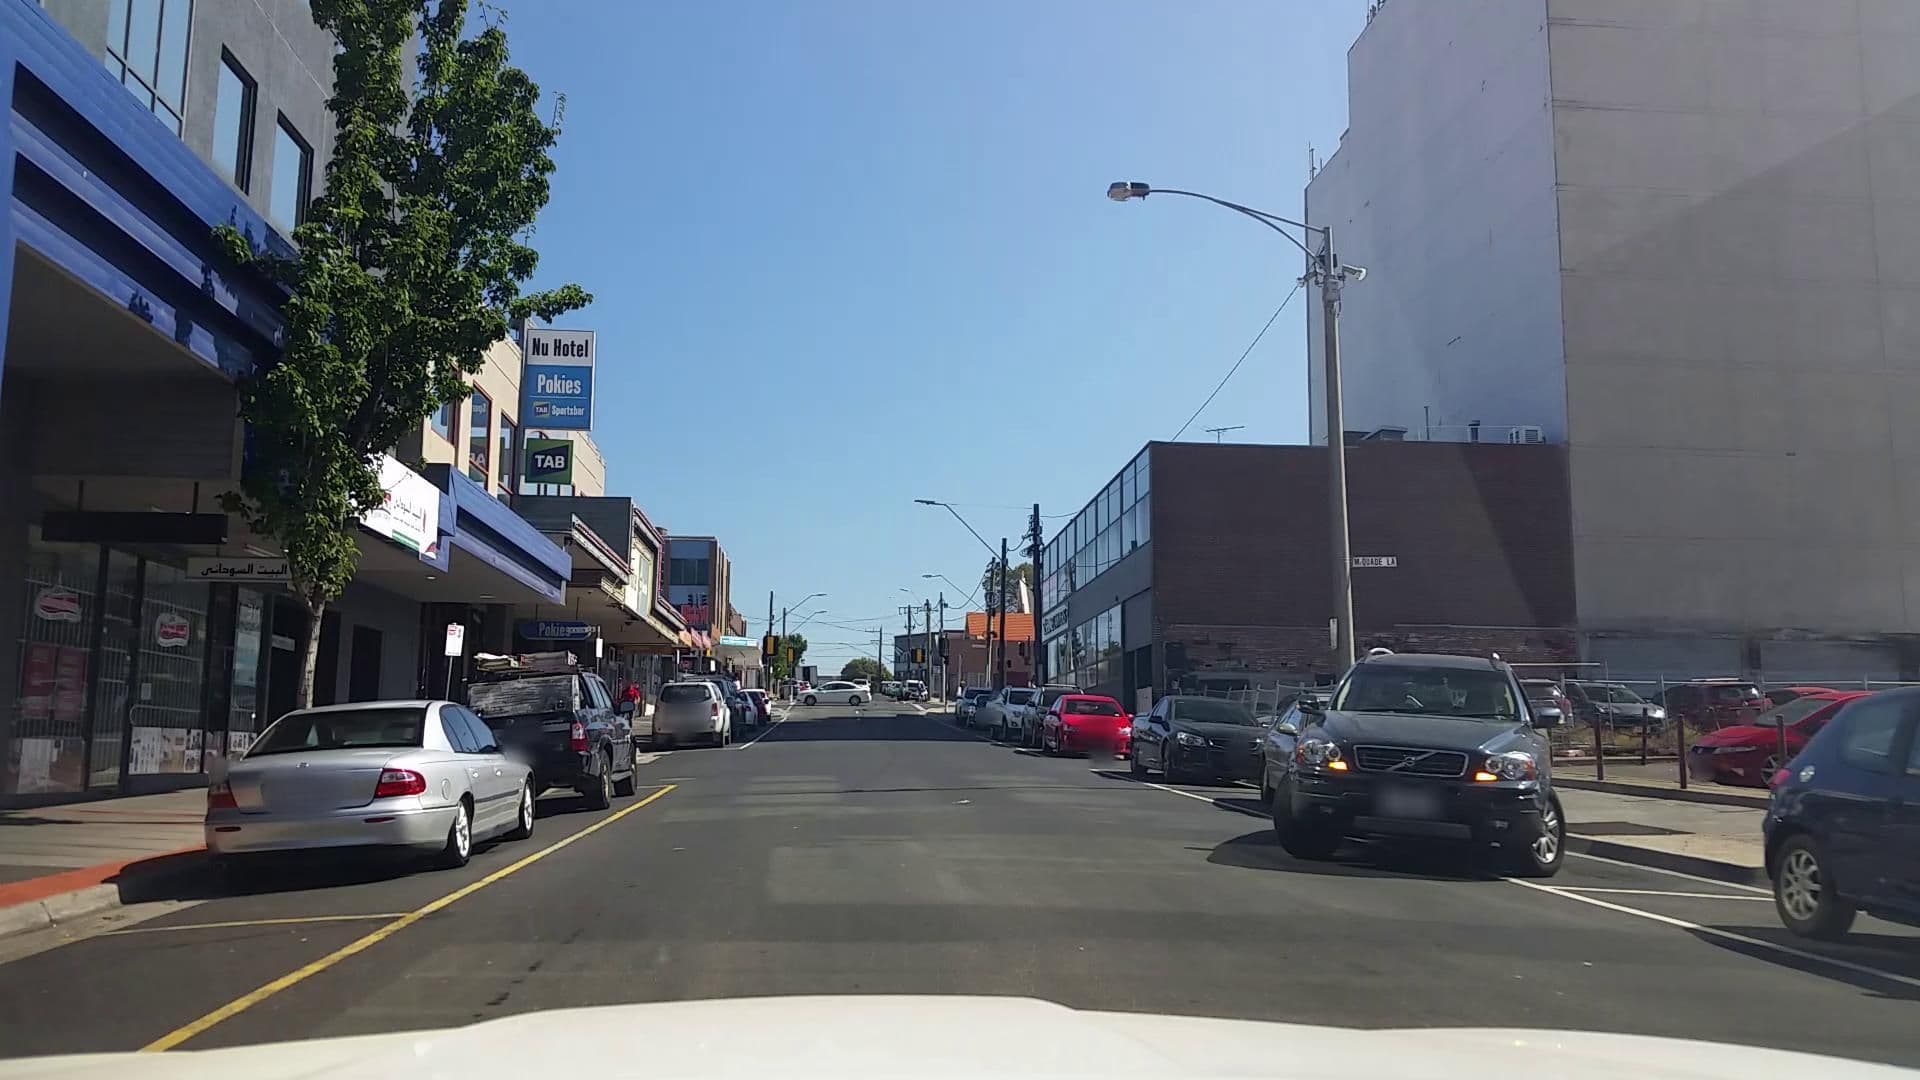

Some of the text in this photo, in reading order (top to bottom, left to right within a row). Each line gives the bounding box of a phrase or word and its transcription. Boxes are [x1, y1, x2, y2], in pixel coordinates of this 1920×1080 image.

[532, 338, 589, 358] Nu Hotel
[537, 374, 581, 394] Pokies
[551, 405, 585, 416] Sportsbar
[534, 455, 565, 469] TAB
